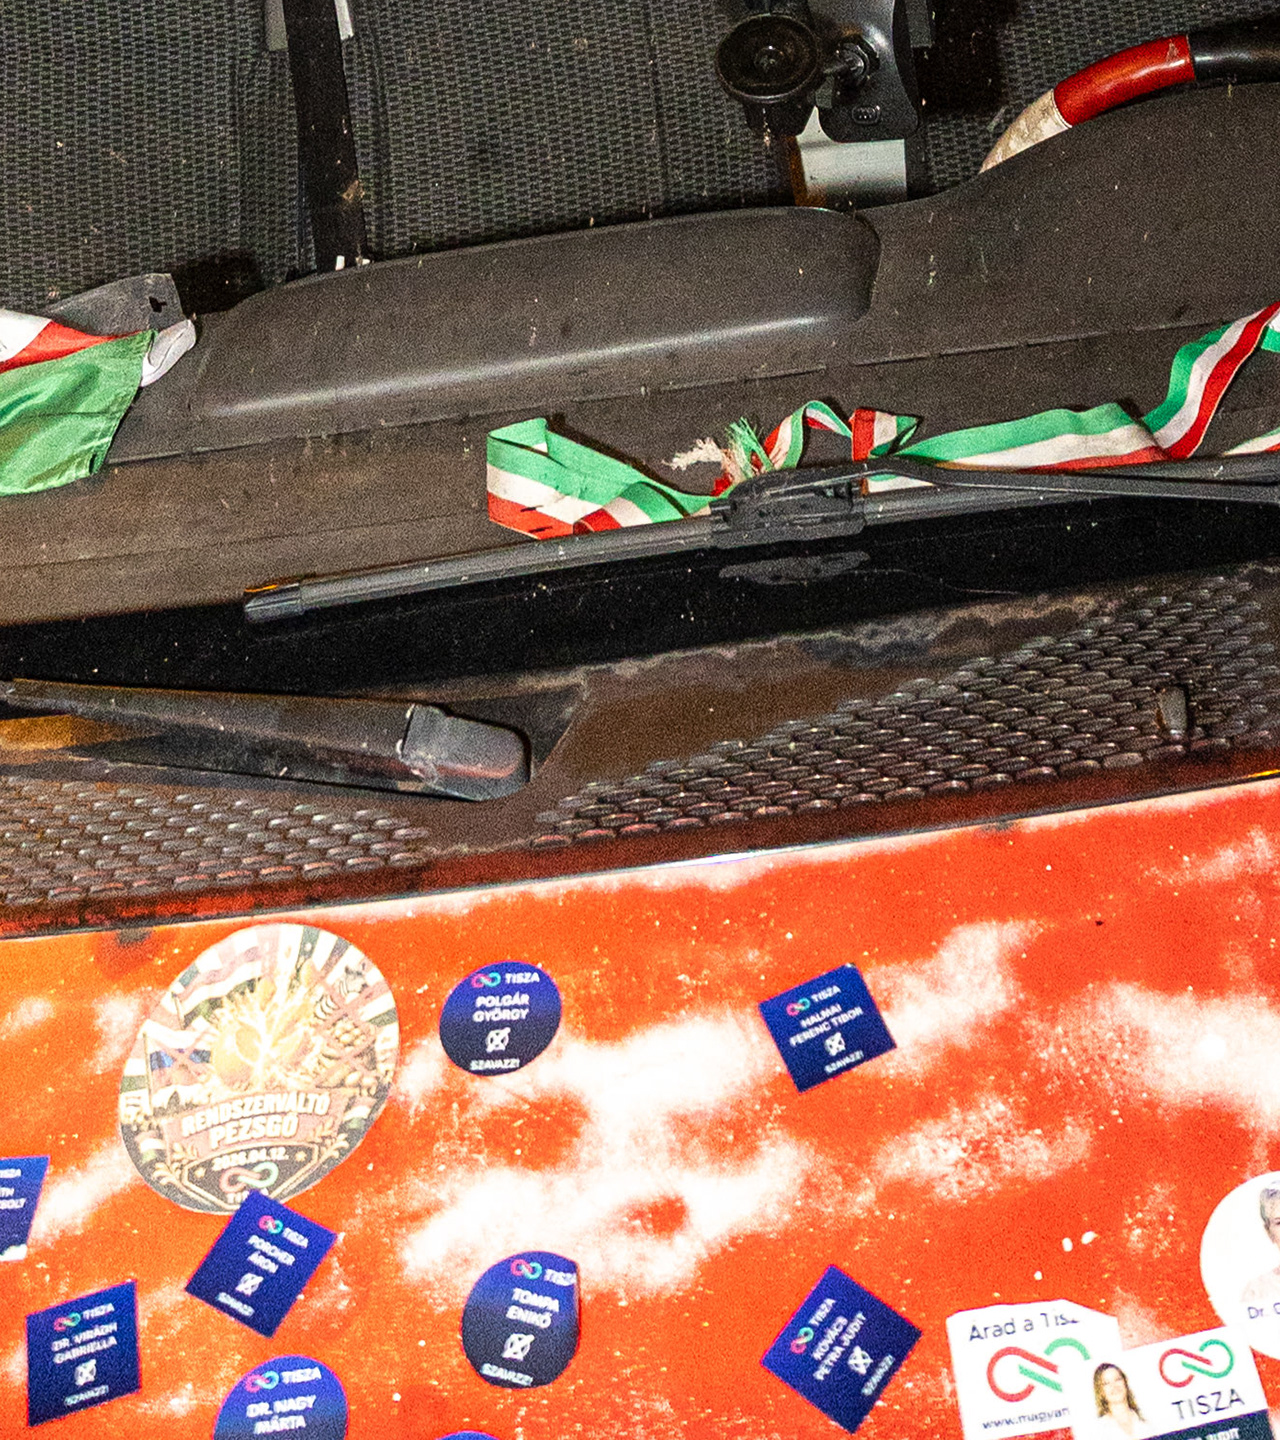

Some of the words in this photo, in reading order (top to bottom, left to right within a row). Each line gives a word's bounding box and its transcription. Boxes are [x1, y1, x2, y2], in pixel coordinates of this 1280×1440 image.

[505, 972, 540, 984] TISZA
[476, 991, 529, 1007] POLGÁR
[811, 985, 841, 1002] TISZA
[473, 1007, 529, 1022] GYÖRGY
[800, 1003, 842, 1028] HALMAI
[789, 1021, 832, 1047] FERENC
[470, 1058, 520, 1070] SZAVAZZ!
[282, 1228, 308, 1247] TISZA
[512, 1287, 560, 1312] TOMPA
[83, 1303, 115, 1320] TISZA
[808, 1297, 836, 1327] TISZA
[839, 1311, 866, 1346] JUDIT
[1023, 1319, 1035, 1332] a
[811, 1315, 848, 1361] KOVÁCS
[281, 1366, 322, 1384] TISZA
[246, 1399, 272, 1418] DR.
[273, 1395, 316, 1415] NAGY
[1171, 1388, 1245, 1419] TISZA
[254, 1414, 306, 1435] MÁRTA
